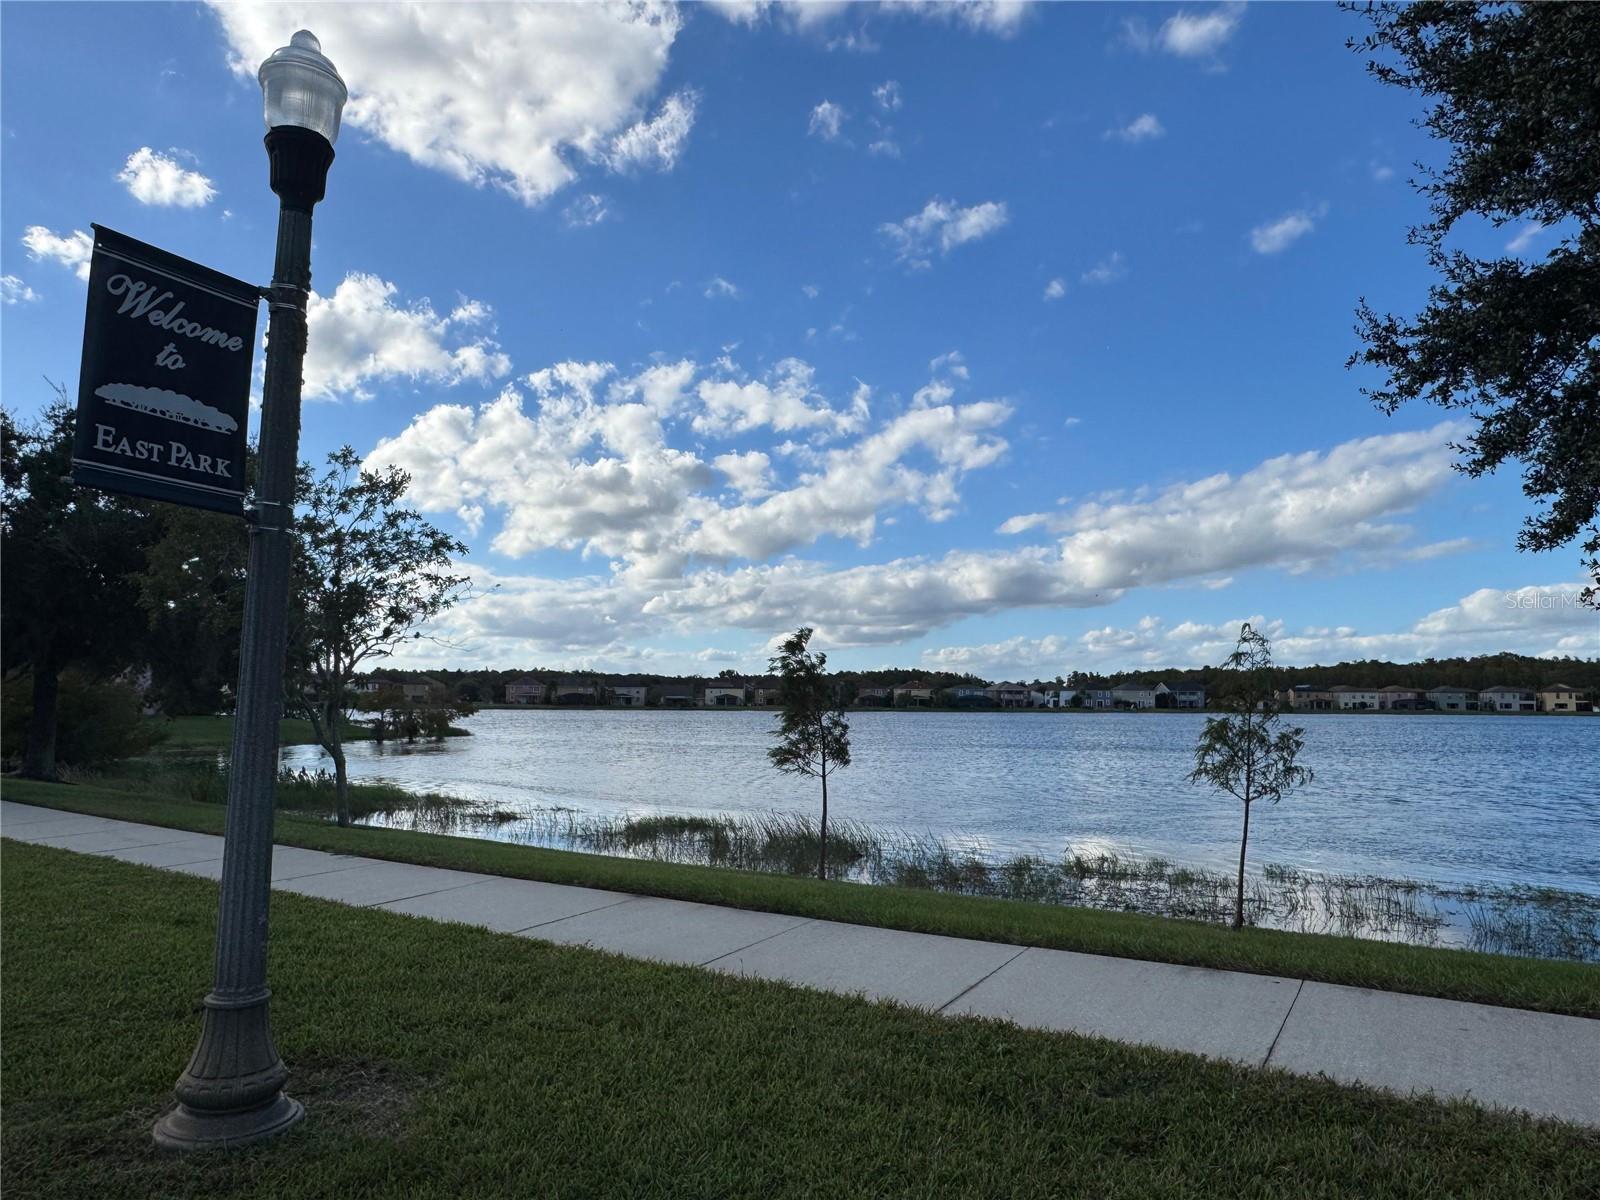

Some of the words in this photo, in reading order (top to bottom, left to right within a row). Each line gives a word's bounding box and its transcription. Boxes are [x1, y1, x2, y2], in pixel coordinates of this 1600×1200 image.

[106, 274, 242, 351] Welcome
[155, 342, 186, 370] to
[94, 424, 164, 462] EAST
[168, 442, 232, 478] PARK
